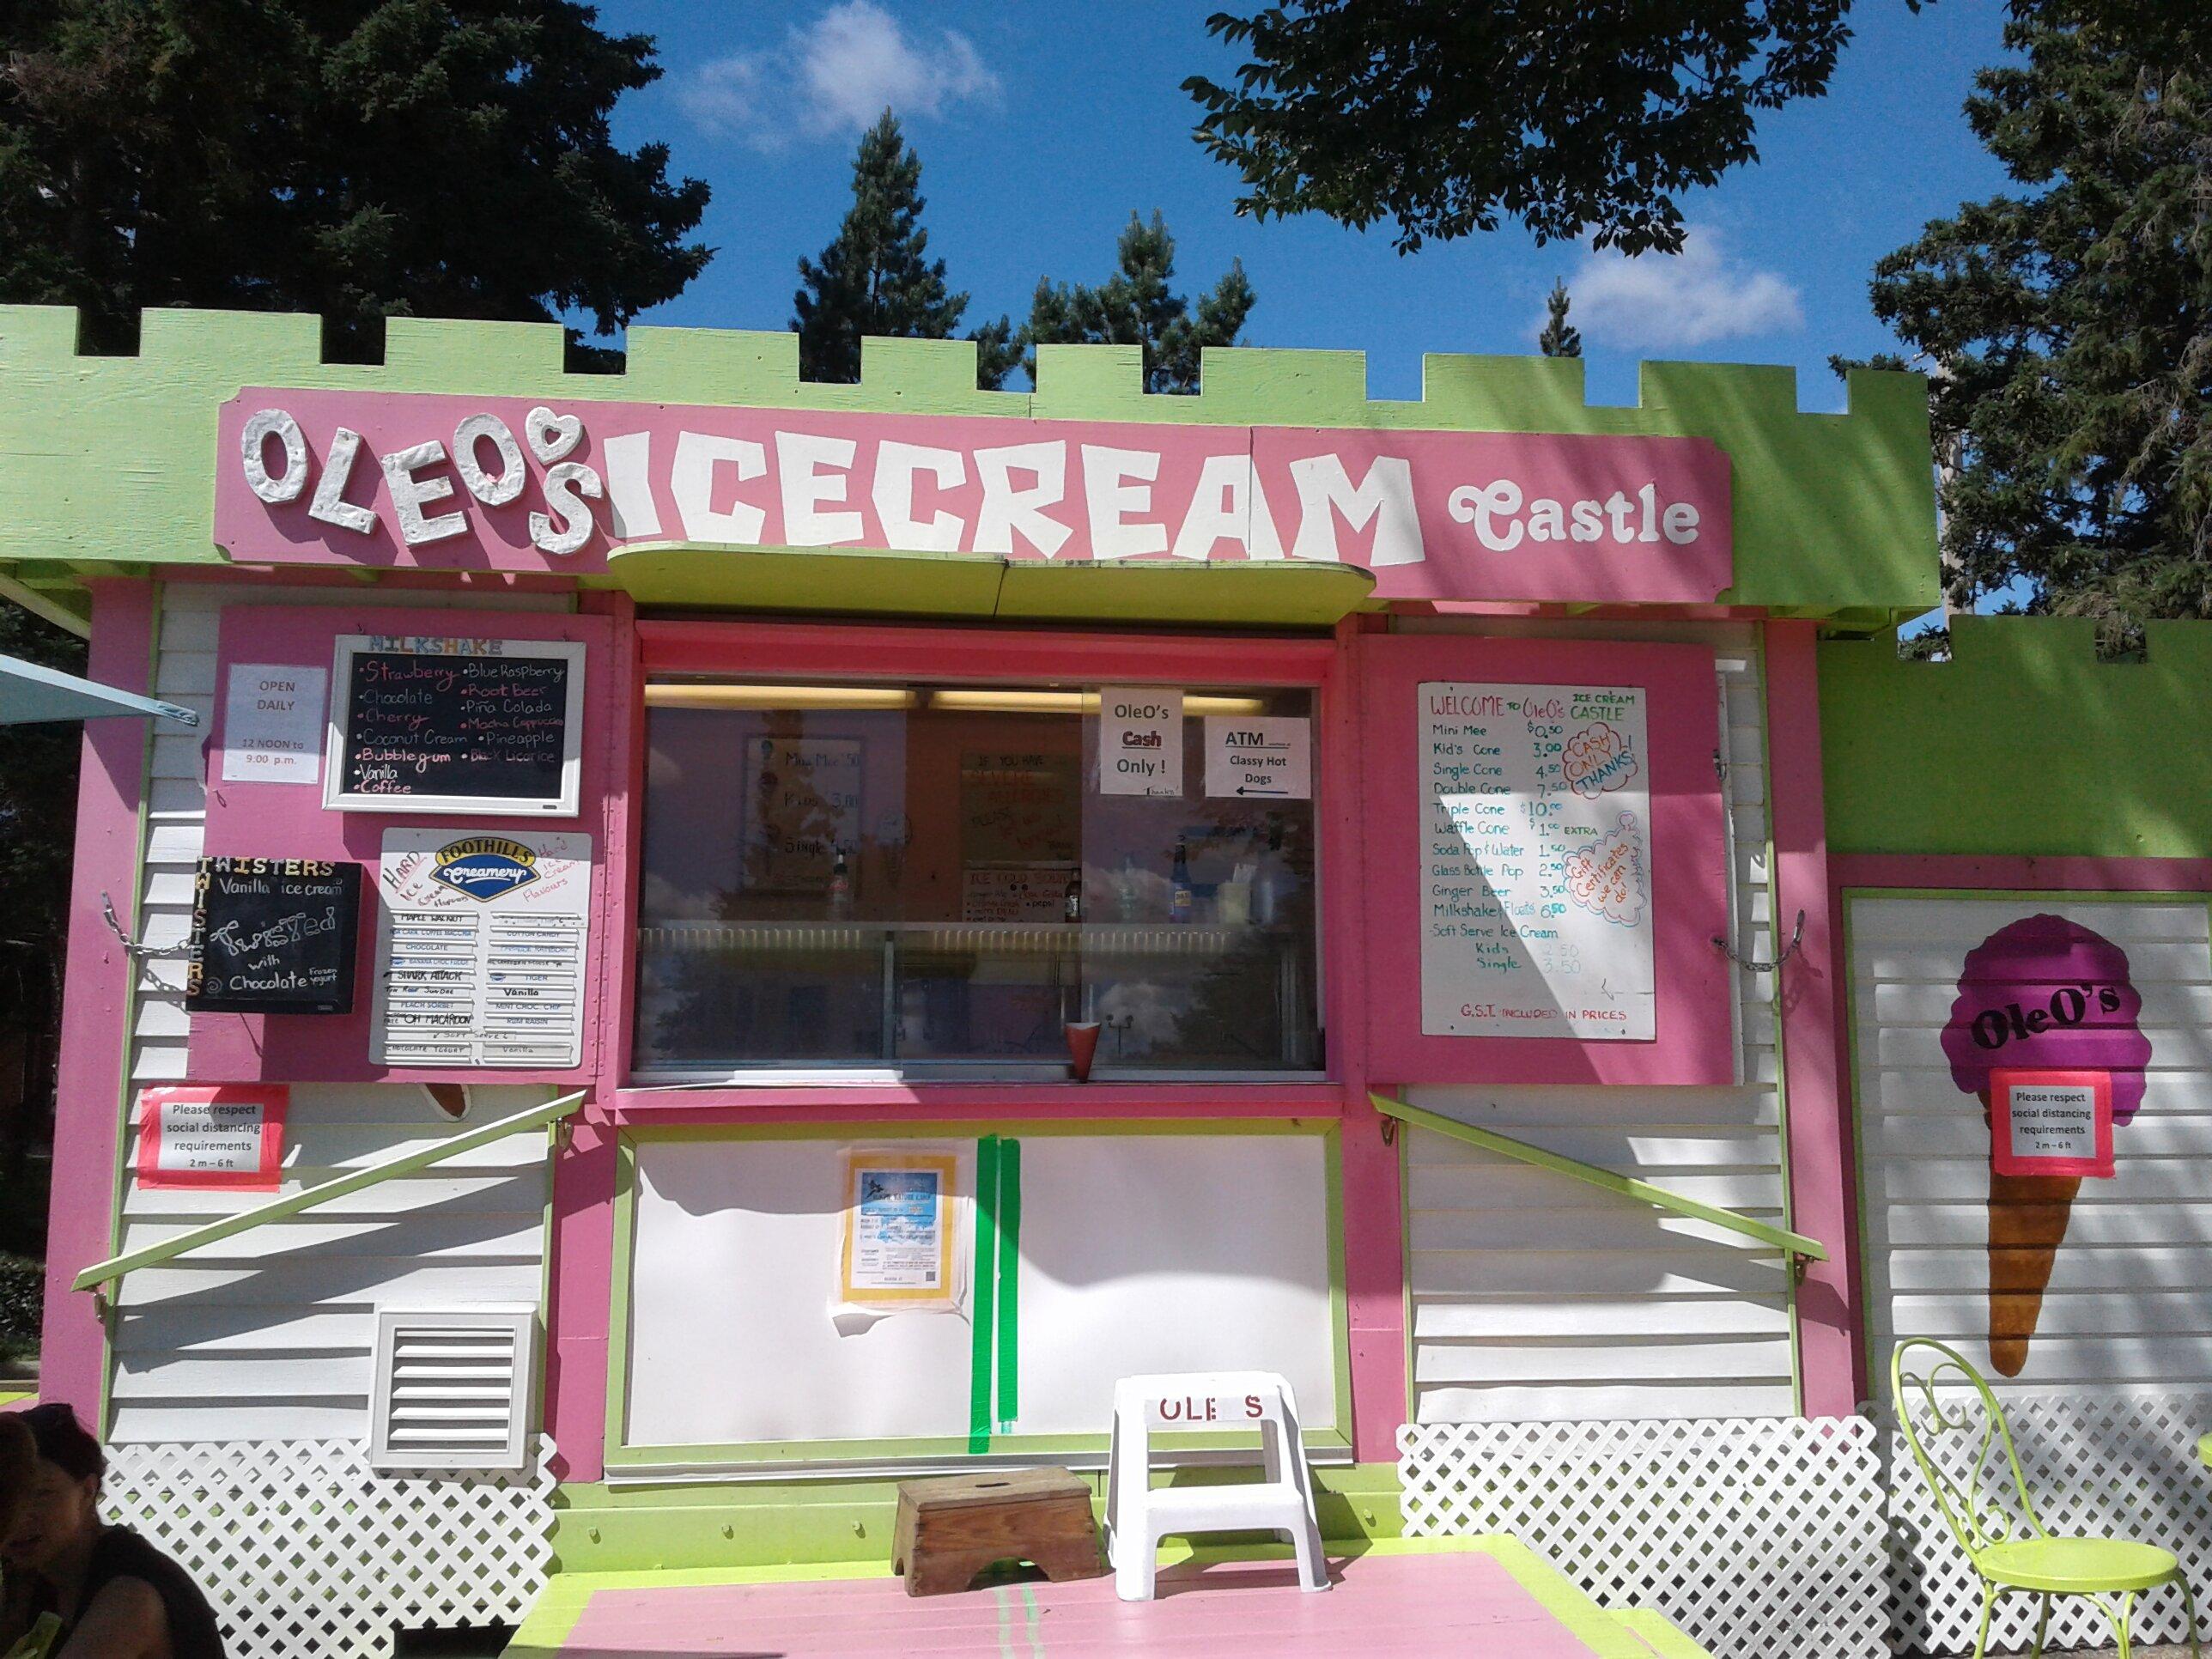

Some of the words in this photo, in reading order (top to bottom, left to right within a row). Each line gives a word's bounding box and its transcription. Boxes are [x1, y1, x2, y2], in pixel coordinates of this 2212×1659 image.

[1448, 479, 1700, 552] Castle
[369, 635, 503, 655] MILKSHAKE
[366, 659, 461, 691] Strawberry
[468, 663, 498, 678] Blue
[501, 664, 564, 683] Raspberry
[259, 681, 295, 692] OPEN
[468, 684, 508, 697] Root
[363, 689, 433, 705] Chocolate
[1573, 693, 1591, 703] ICE
[1595, 694, 1635, 704] CREAM
[257, 700, 295, 711] DAILY
[503, 699, 552, 714] Colada
[1115, 704, 1169, 720] OleO's
[1431, 696, 1504, 717] WELCOME
[1507, 702, 1521, 712] TO
[1571, 705, 1626, 721] CASTLE
[366, 708, 429, 730] Cherry
[468, 717, 510, 729] Mocha
[363, 728, 419, 745] Coconut
[424, 729, 467, 745] Cream
[1122, 731, 1162, 747] Cash
[1225, 732, 1264, 746] ATM
[1432, 725, 1459, 736] Mini
[1463, 726, 1487, 737] Mee
[242, 738, 254, 748] 12
[258, 739, 290, 750] NOON
[293, 740, 304, 750] to
[486, 732, 556, 749] Pineapple
[1572, 732, 1611, 757] CASH
[1474, 744, 1501, 756] Cone
[1117, 758, 1155, 776] Only
[1230, 755, 1264, 769] Classy
[1267, 756, 1287, 767] Hot
[359, 764, 398, 780] Vanilla
[1245, 773, 1272, 786] Dogs
[1433, 763, 1469, 781] Single
[1474, 764, 1503, 776] Cone
[360, 779, 411, 794] Coffee
[1434, 782, 1476, 795] Double
[1480, 782, 1511, 795] Cone
[1432, 802, 1469, 818] Triple
[1475, 803, 1505, 816] Cone
[1435, 820, 1474, 834] Waffle
[1477, 821, 1510, 835] Cone
[1565, 827, 1598, 836] EXTRA
[439, 839, 532, 864] FOOTHILLS
[1432, 843, 1459, 856] Soda
[1463, 843, 1483, 860] Pop
[1492, 843, 1525, 857] Water
[198, 857, 336, 877] TWISTERS
[383, 851, 421, 890] HARD
[444, 866, 527, 884] Creamery
[1432, 864, 1461, 876] Glass
[1501, 865, 1524, 880] Pop
[1571, 857, 1594, 878] Gift
[1610, 865, 1626, 885] can
[220, 878, 270, 895] Vanilla
[281, 882, 301, 896] ice
[305, 883, 343, 896] cream
[1432, 884, 1474, 902] Ginger
[1482, 886, 1511, 897] Beer
[1460, 924, 1493, 938] Serve
[1500, 924, 1517, 938] Ice
[1520, 925, 1559, 939] Cream
[248, 954, 280, 970] with
[1476, 956, 1522, 974] Single
[229, 971, 308, 991] Chocolate
[503, 988, 539, 997] Vanilla
[1502, 1008, 1558, 1019] INCLUDED
[1565, 1009, 1577, 1019] IN
[1582, 1009, 1627, 1021] PRICES
[1972, 982, 2121, 1049] OleO's
[2016, 1092, 2048, 1103] Please
[2050, 1092, 2086, 1105] respect
[173, 1104, 210, 1115] Please
[214, 1105, 257, 1117] respect
[2012, 1109, 2040, 1118] social
[2042, 1109, 2092, 1121] distancing
[167, 1122, 199, 1133] social
[202, 1122, 261, 1134] distancing
[2020, 1125, 2086, 1136] requirements
[173, 1141, 252, 1154] requirements
[2035, 1141, 2040, 1150] 2
[2058, 1141, 2063, 1150] 6
[2064, 1141, 2072, 1150] ft
[190, 1159, 196, 1168] 2
[217, 1159, 223, 1168] 6
[225, 1159, 234, 1168] ft
